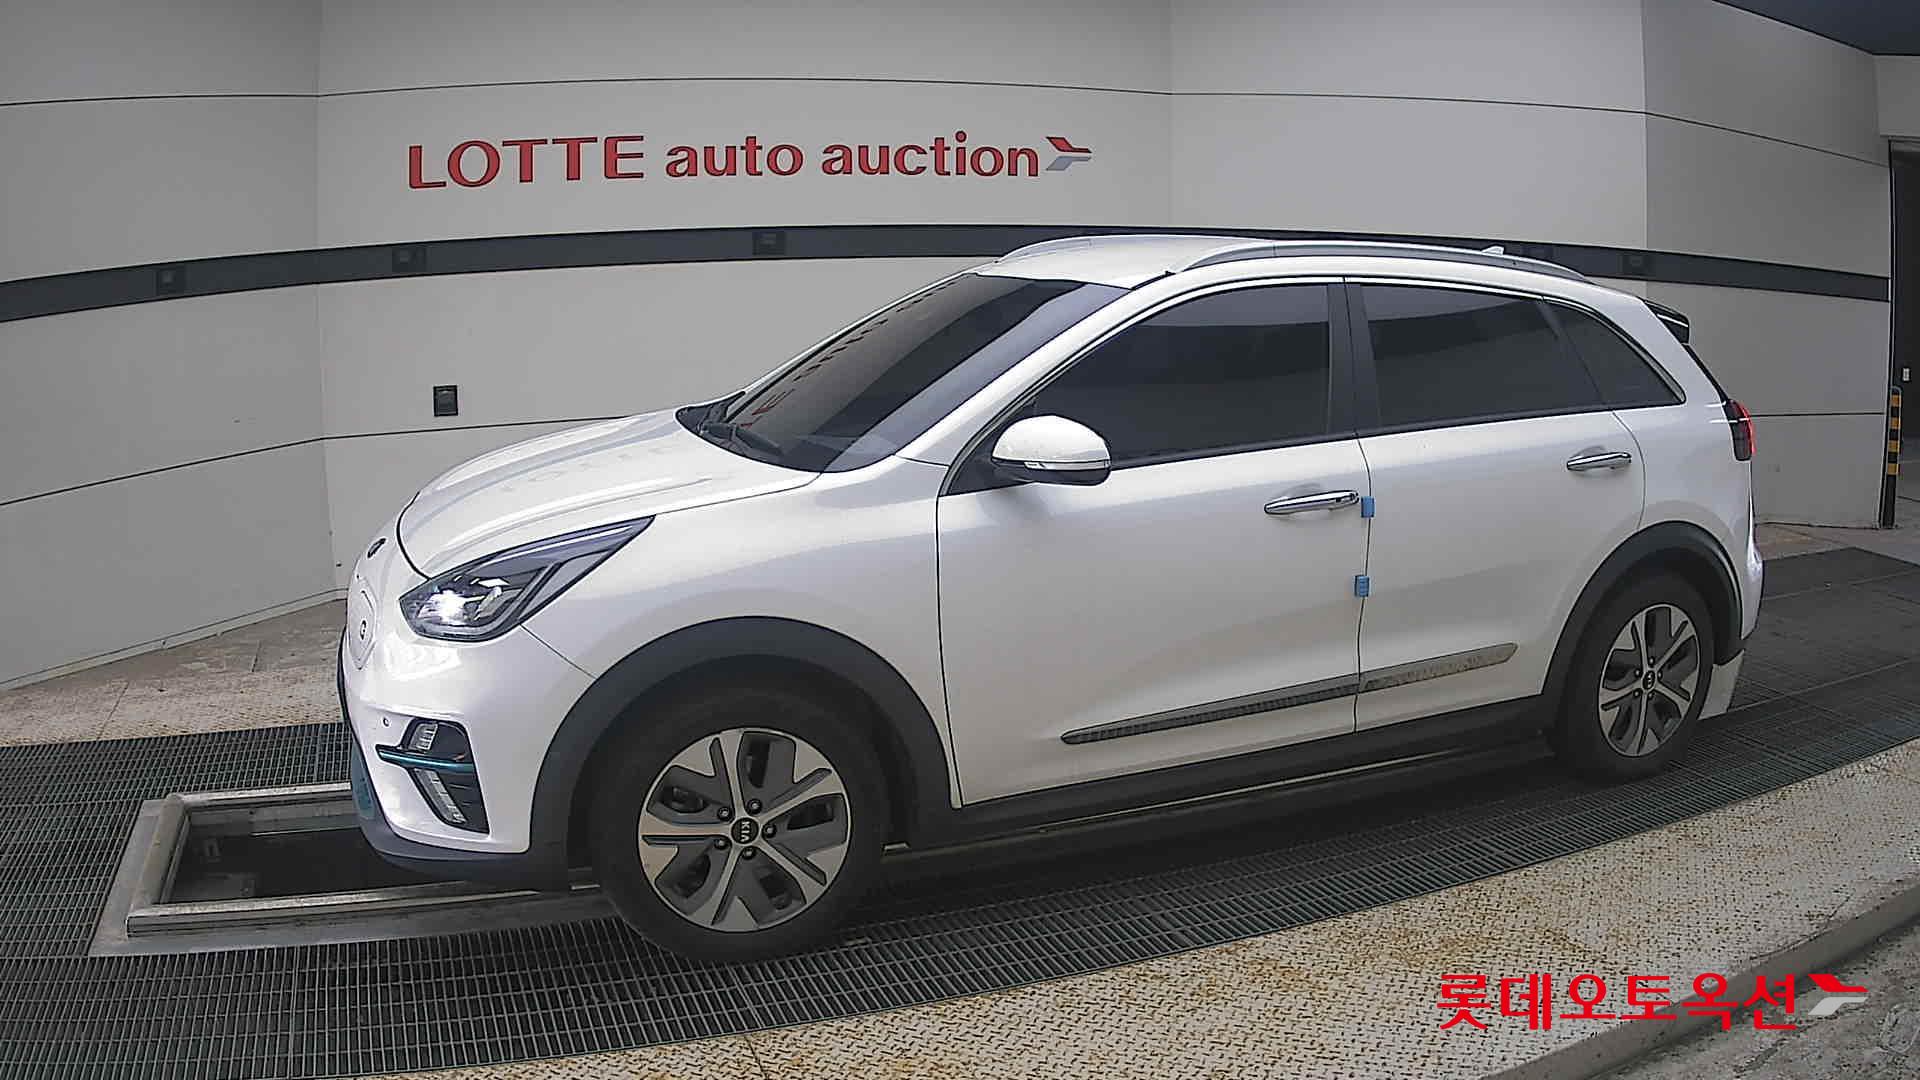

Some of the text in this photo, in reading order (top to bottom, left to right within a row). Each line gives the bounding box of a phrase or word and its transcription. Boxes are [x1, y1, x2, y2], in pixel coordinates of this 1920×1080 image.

[409, 130, 1040, 188] LOTTE auto auction
[741, 821, 750, 842] KIA
